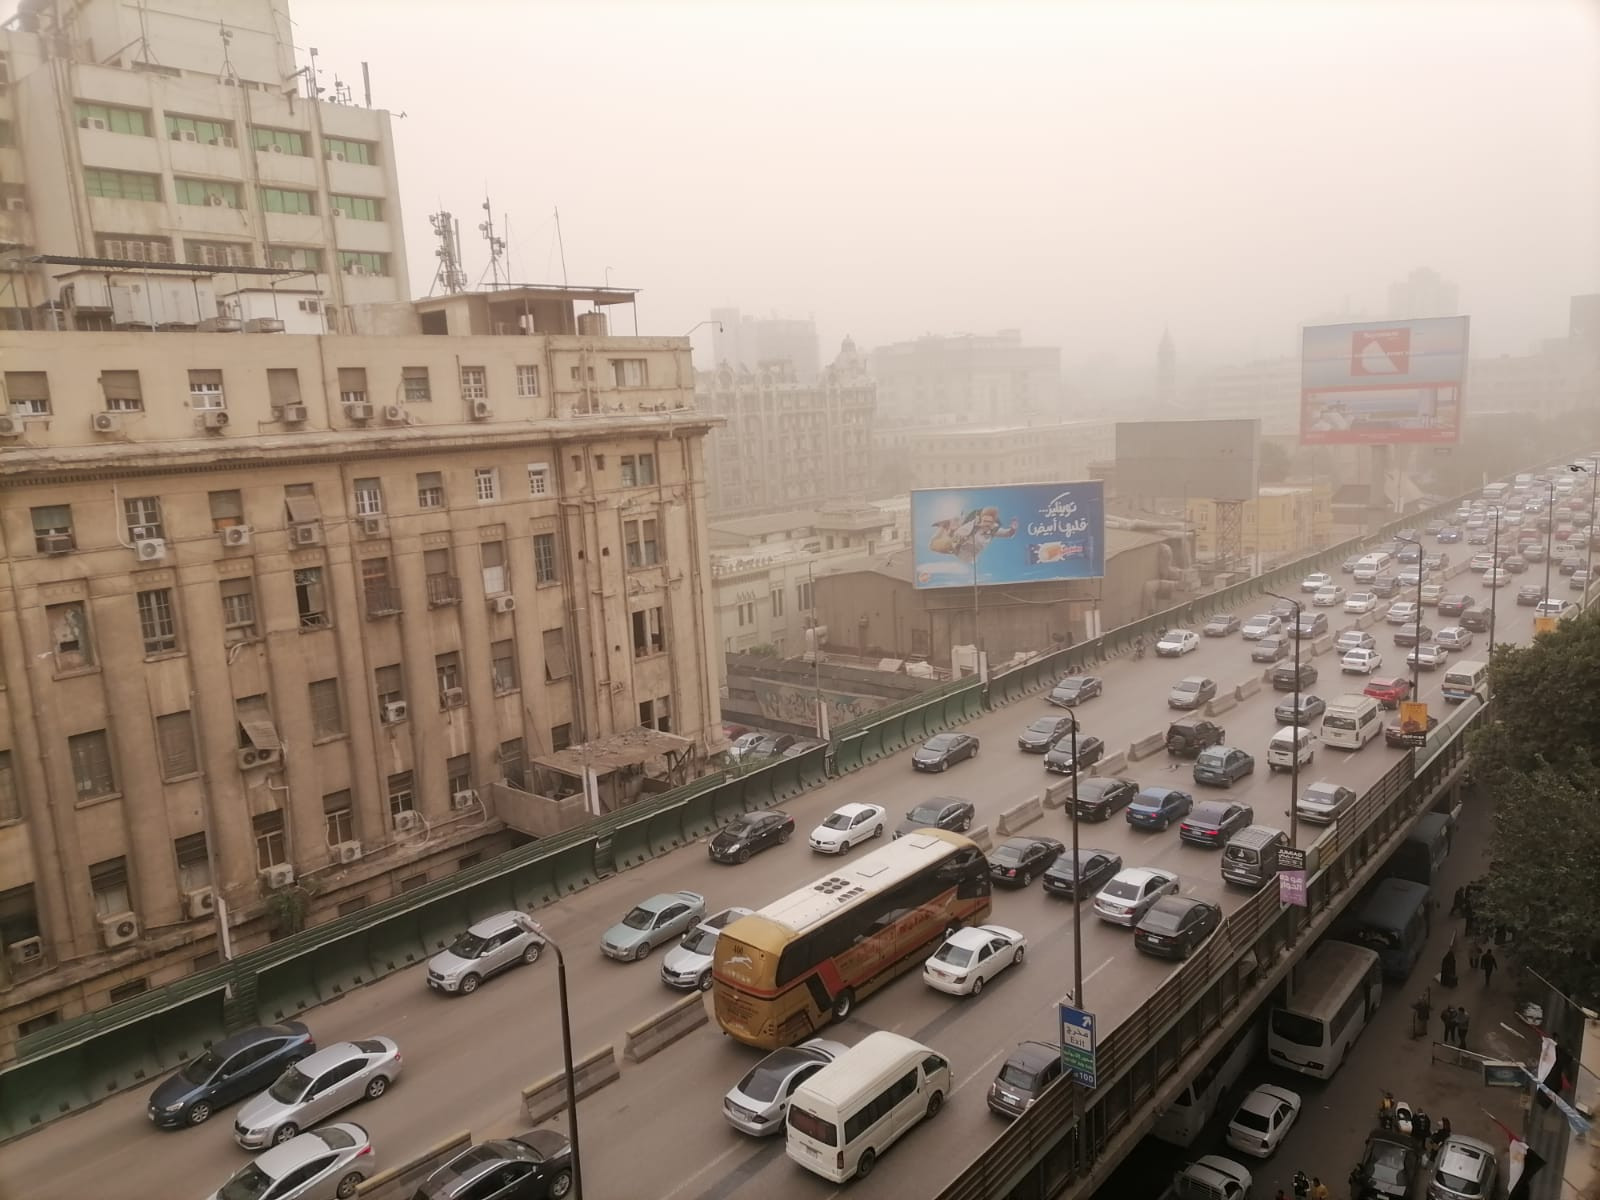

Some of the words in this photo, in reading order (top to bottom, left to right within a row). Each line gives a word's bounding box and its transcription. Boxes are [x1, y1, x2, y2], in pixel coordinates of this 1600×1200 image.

[1027, 517, 1057, 536] أبيض
[1058, 517, 1088, 537] قلبها
[1066, 1026, 1088, 1038] مخرج
[1070, 1036, 1085, 1048] Exit
